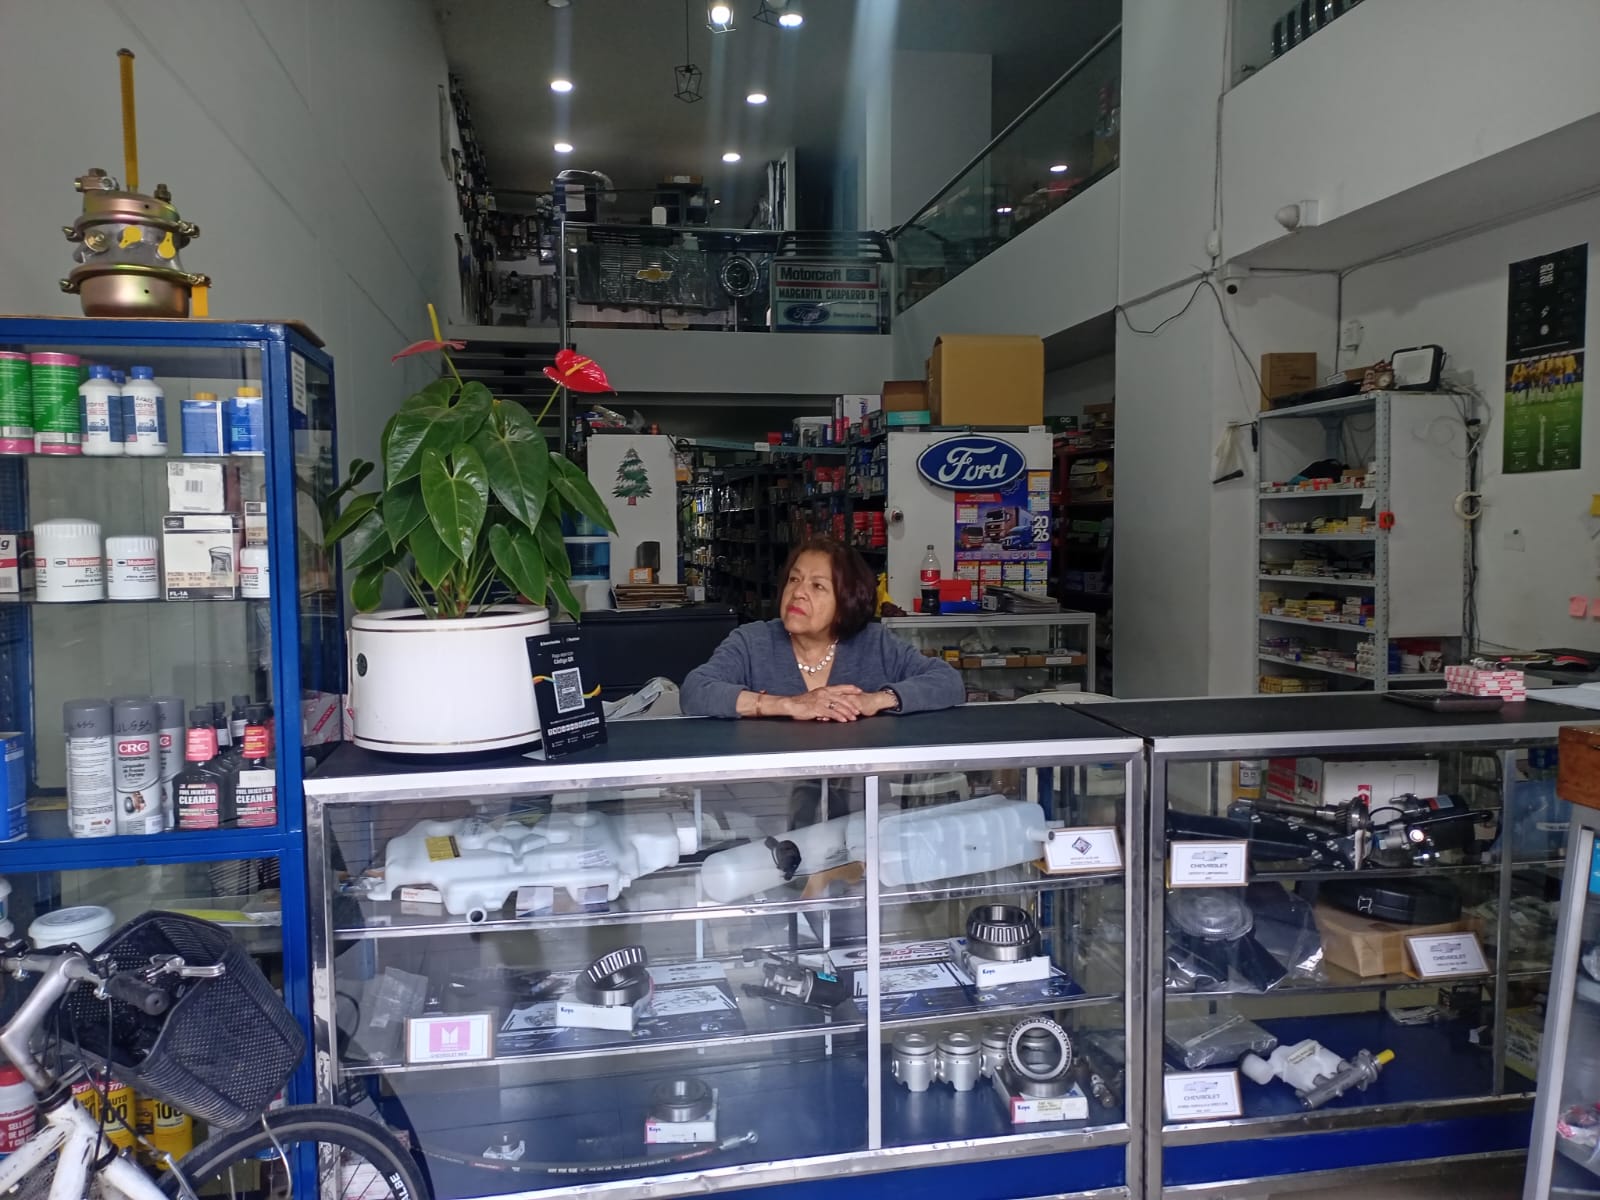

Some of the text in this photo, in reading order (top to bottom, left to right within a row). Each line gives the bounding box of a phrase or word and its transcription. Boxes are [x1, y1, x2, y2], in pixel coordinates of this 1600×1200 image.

[780, 267, 842, 281] Motorcraft
[779, 287, 822, 300] MARGARITA
[826, 289, 865, 300] CHAPARRO
[937, 445, 1009, 483] Ford
[1034, 515, 1049, 529] 20
[1033, 528, 1050, 542] 26
[119, 742, 149, 754] CRC
[178, 796, 216, 805] CLEANER
[236, 794, 273, 804] CLEANER
[1184, 1093, 1221, 1101] CHEVROLET
